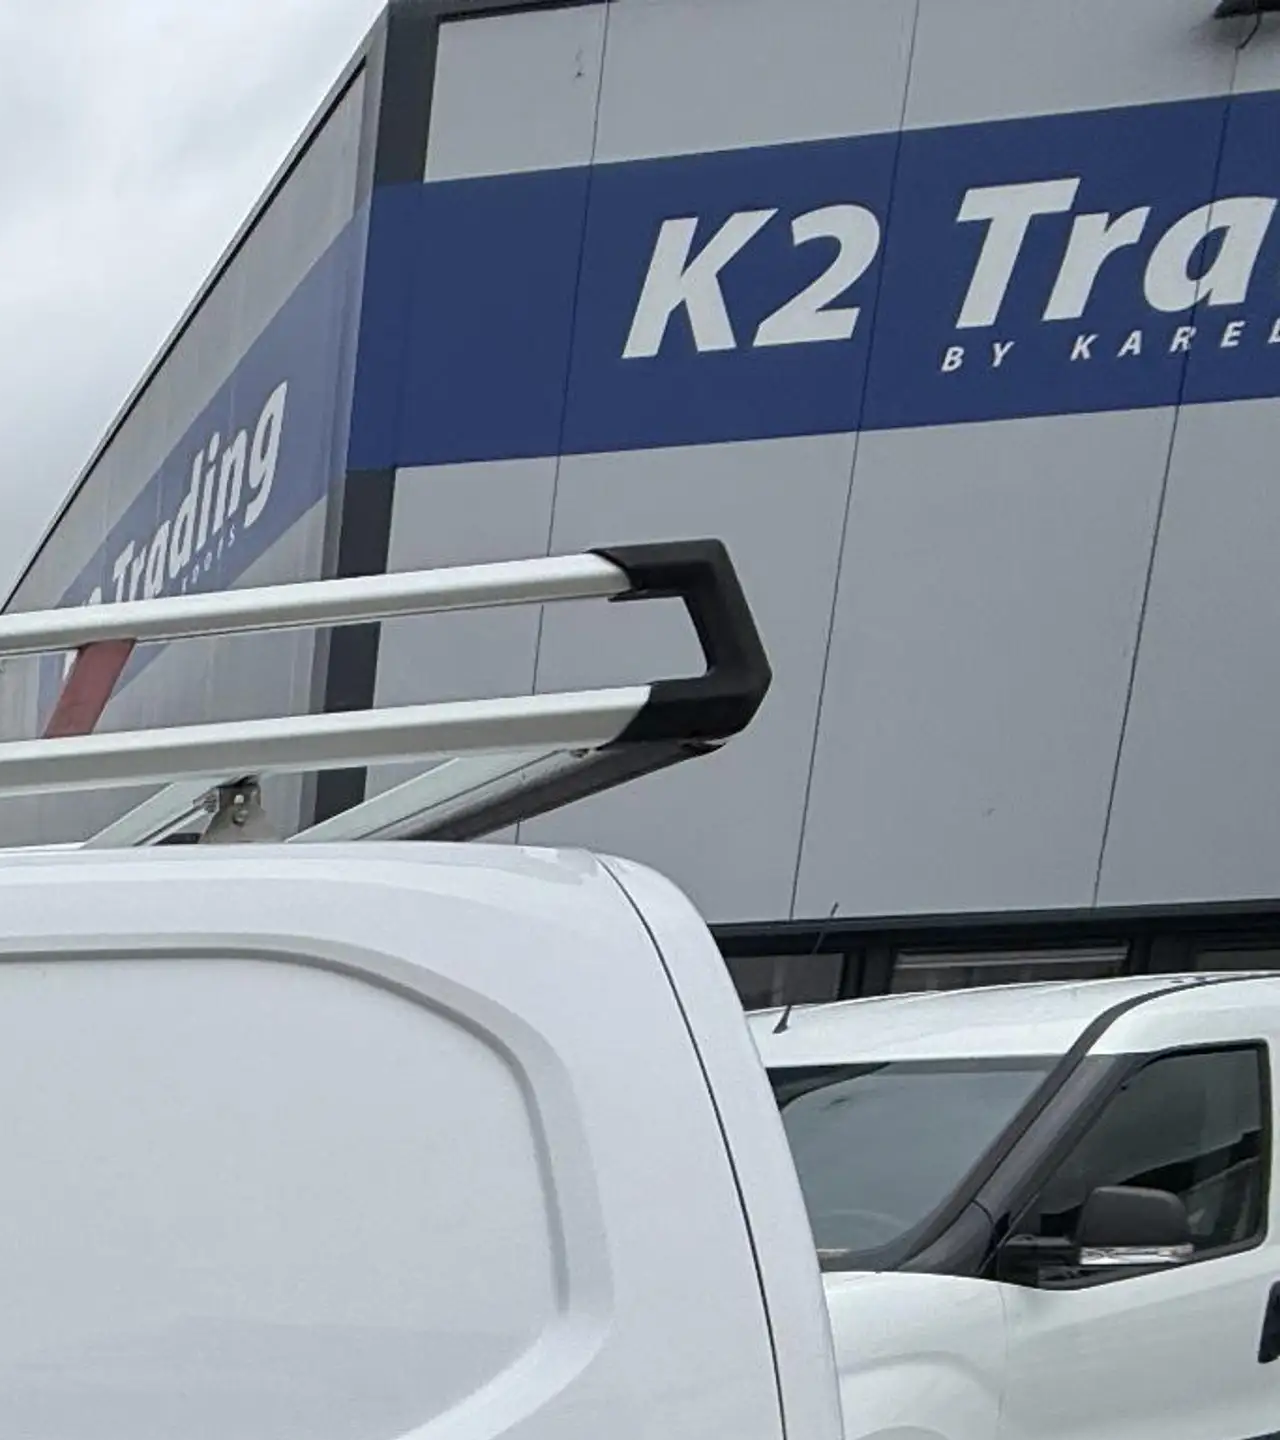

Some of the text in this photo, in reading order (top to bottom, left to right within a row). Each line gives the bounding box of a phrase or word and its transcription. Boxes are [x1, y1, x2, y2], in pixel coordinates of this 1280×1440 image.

[621, 177, 1279, 359] K2 Tra
[941, 341, 1015, 373] BY
[112, 380, 288, 603] Trading
